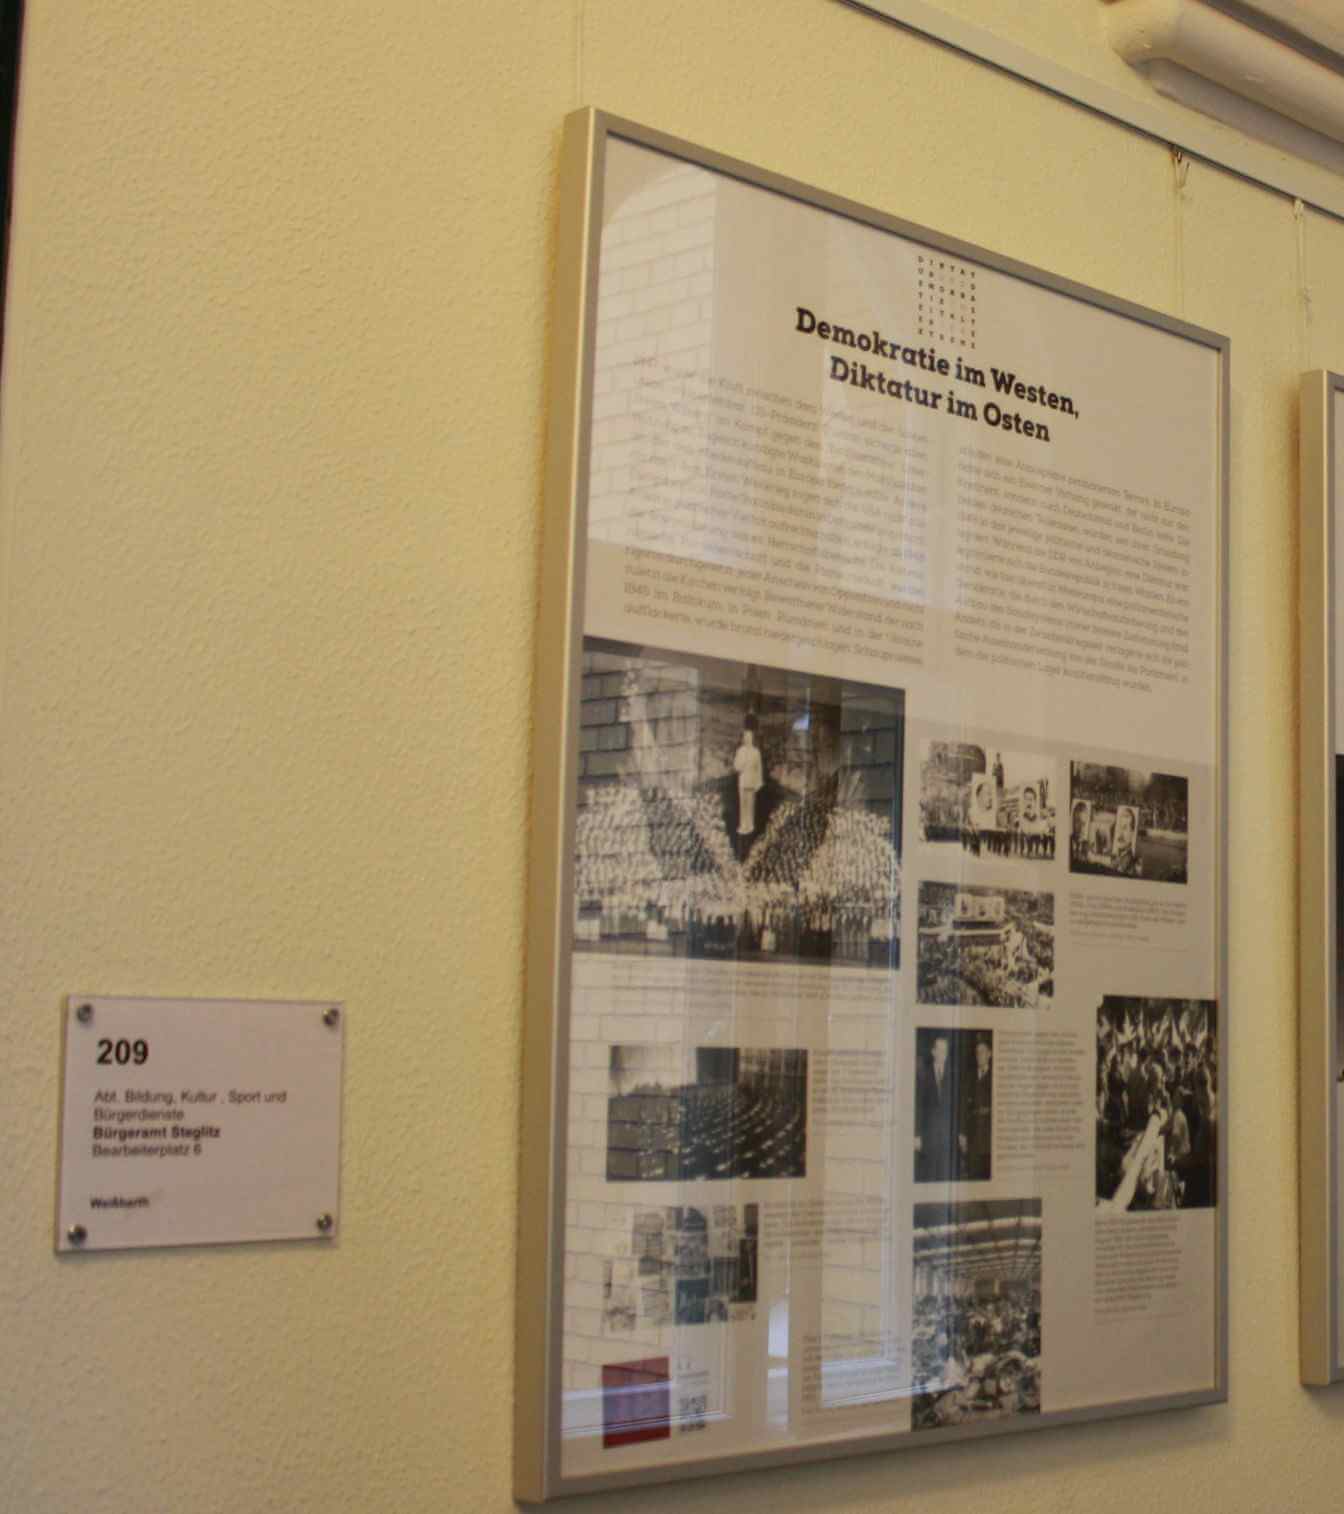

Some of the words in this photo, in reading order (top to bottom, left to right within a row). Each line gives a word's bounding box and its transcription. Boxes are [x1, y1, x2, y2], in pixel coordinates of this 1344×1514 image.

[795, 307, 950, 376] Demokratie
[955, 357, 986, 387] im
[990, 368, 1080, 418] Westen,
[830, 356, 942, 410] Diktatur
[947, 391, 978, 421] im
[983, 403, 1050, 442] Osten
[97, 1038, 149, 1066] 209
[180, 1090, 217, 1104] Kultur
[228, 1090, 263, 1106] Sport
[264, 1090, 288, 1104] und
[93, 1107, 185, 1123] Bürgerdienste
[93, 1125, 167, 1142] Bürgeramt
[171, 1125, 221, 1141] Steglitz
[92, 1143, 190, 1158] Bearbeiterplatz
